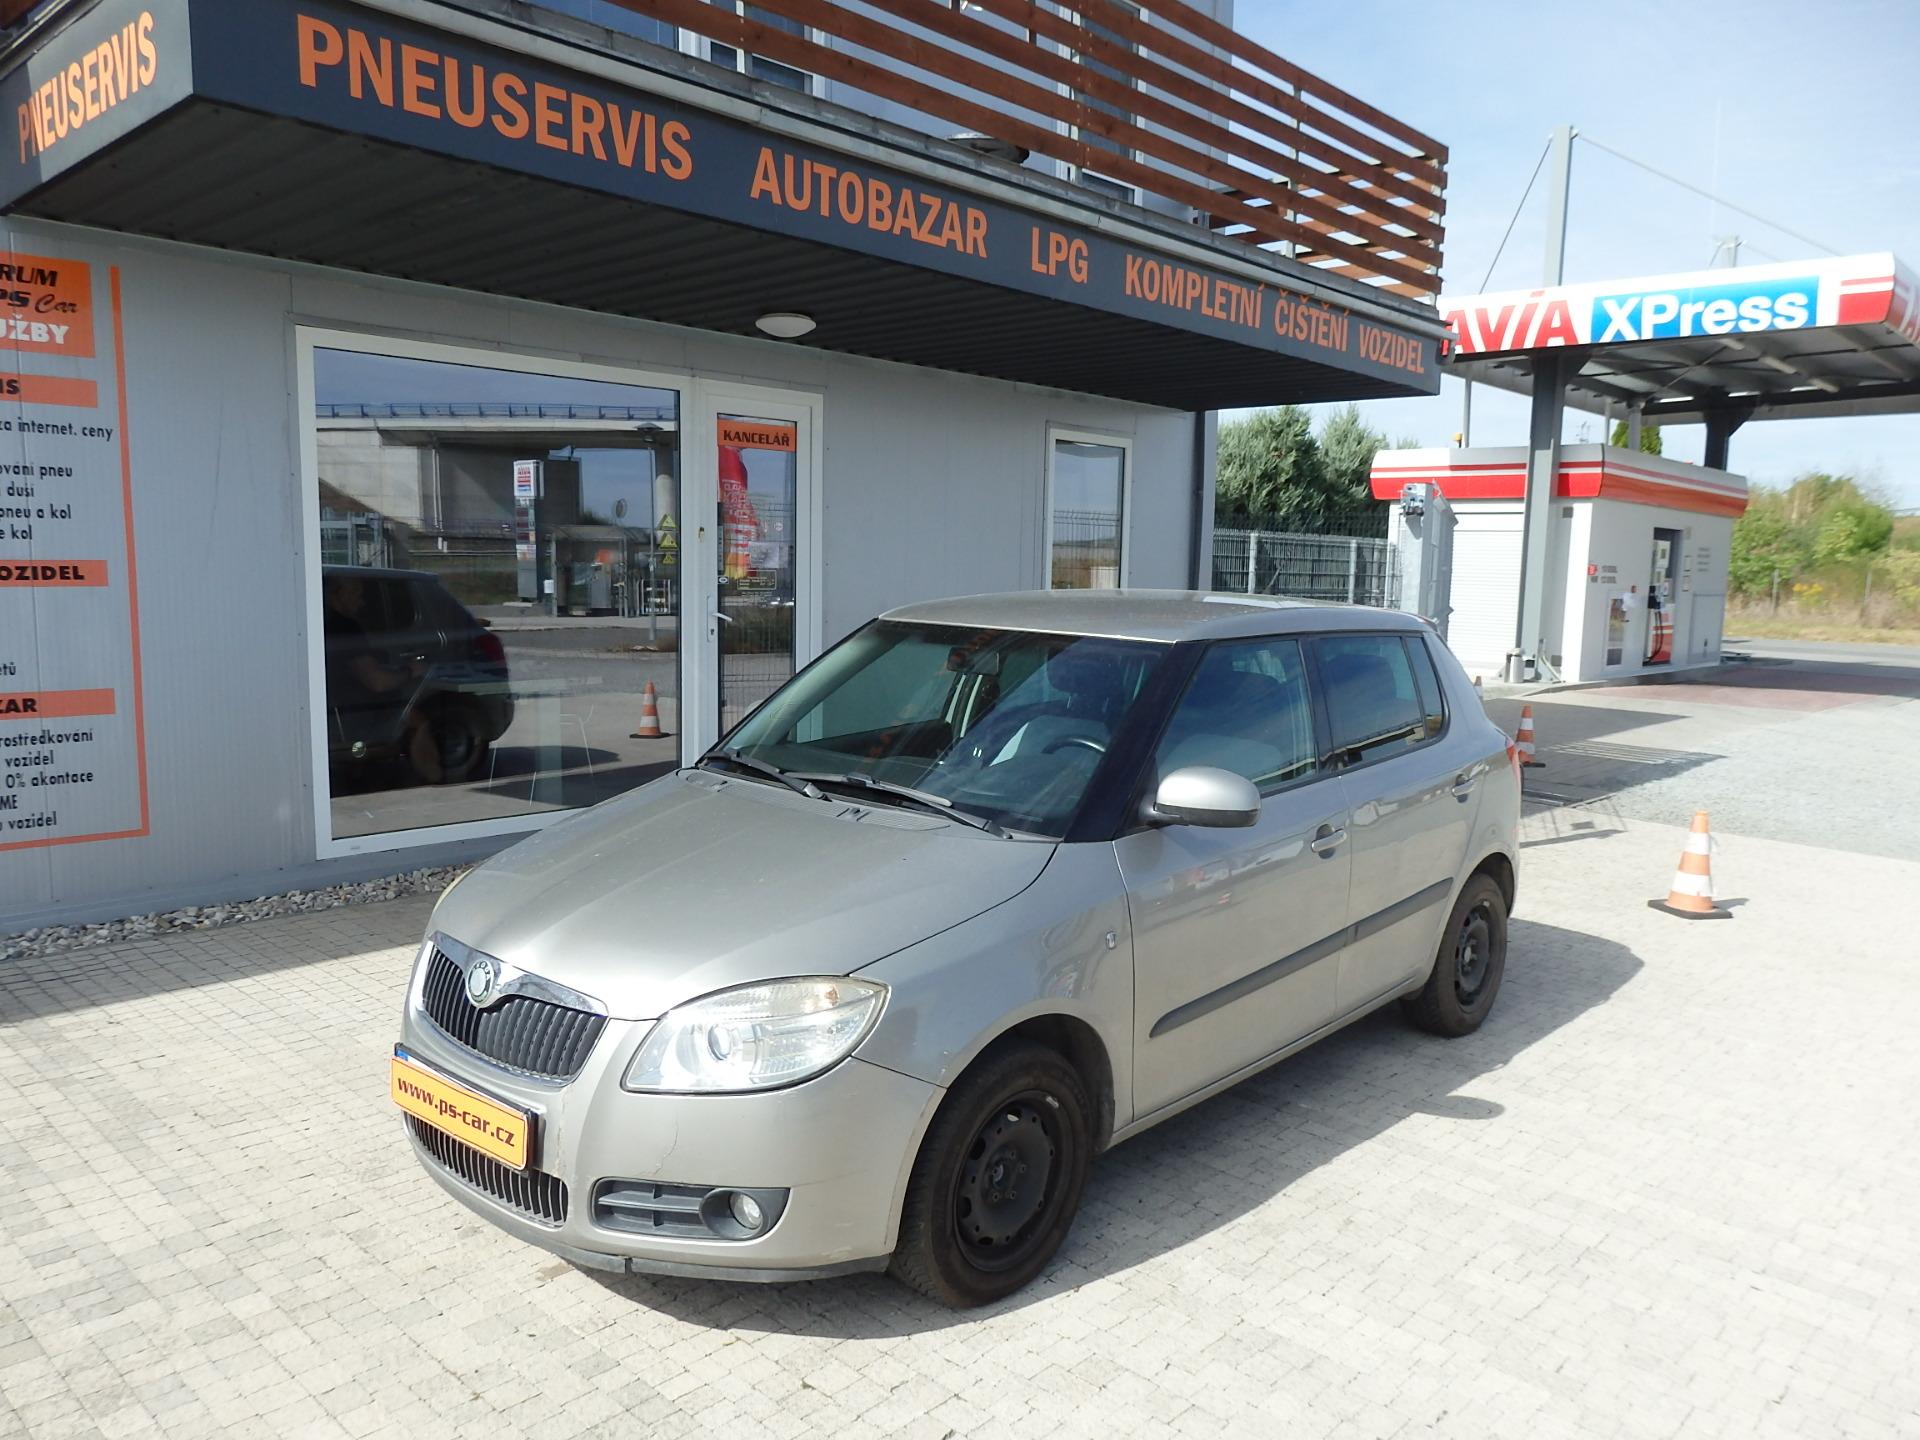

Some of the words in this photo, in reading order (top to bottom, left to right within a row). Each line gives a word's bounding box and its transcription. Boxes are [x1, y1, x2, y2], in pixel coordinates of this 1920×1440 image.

[18, 11, 157, 163] PNEUSERVIS
[297, 14, 692, 180] PNEUSERVIS
[750, 147, 988, 258] AUTOBAZAR
[1031, 226, 1088, 283] LPG
[1125, 254, 1265, 329] KOMPLETNÍ
[1274, 289, 1349, 352] ČIŠTĚNÍ
[1359, 324, 1425, 373] VOZIDEL
[35, 294, 79, 314] Car
[1600, 292, 1810, 344] XPress
[18, 417, 78, 437] internet.
[82, 426, 114, 443] ceny
[723, 429, 790, 447] KANCELÁŘ
[40, 465, 73, 480] pneu
[37, 508, 45, 519] a
[50, 504, 71, 519] kol
[11, 524, 32, 541] kol
[5, 750, 54, 767] vozidel
[6, 772, 26, 789] 0%
[31, 772, 94, 787] akontace
[8, 811, 57, 830] vozidel
[397, 1077, 515, 1148] www.ps-car.cz
